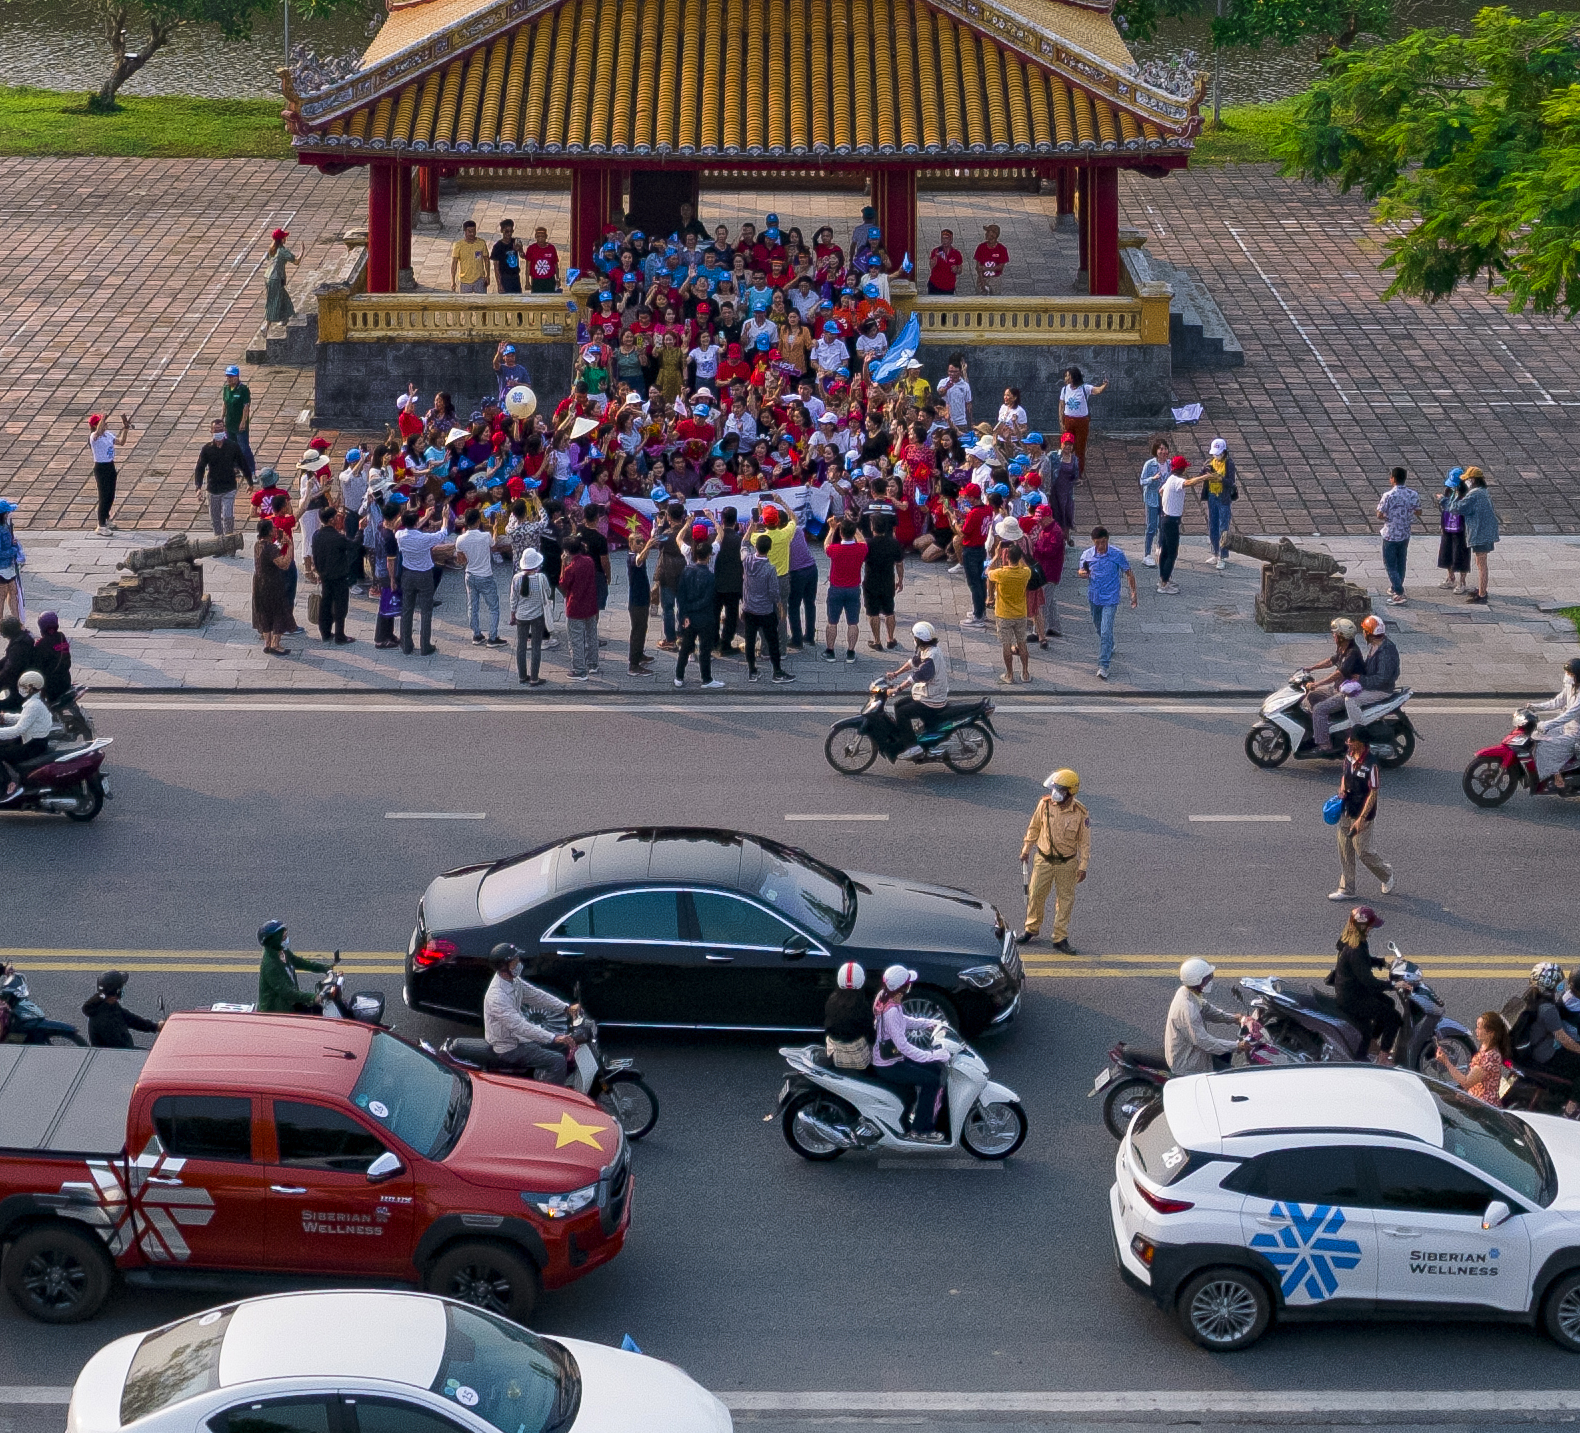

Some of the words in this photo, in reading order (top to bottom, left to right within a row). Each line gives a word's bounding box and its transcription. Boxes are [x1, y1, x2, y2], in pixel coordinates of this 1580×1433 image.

[1161, 1146, 1183, 1168] 28
[301, 1210, 372, 1223] SIBERIAN
[302, 1222, 384, 1236] WELLNESS
[1410, 1250, 1487, 1263] SIBERIAN
[1409, 1263, 1499, 1276] WELLNESS
[461, 1388, 473, 1402] 15
